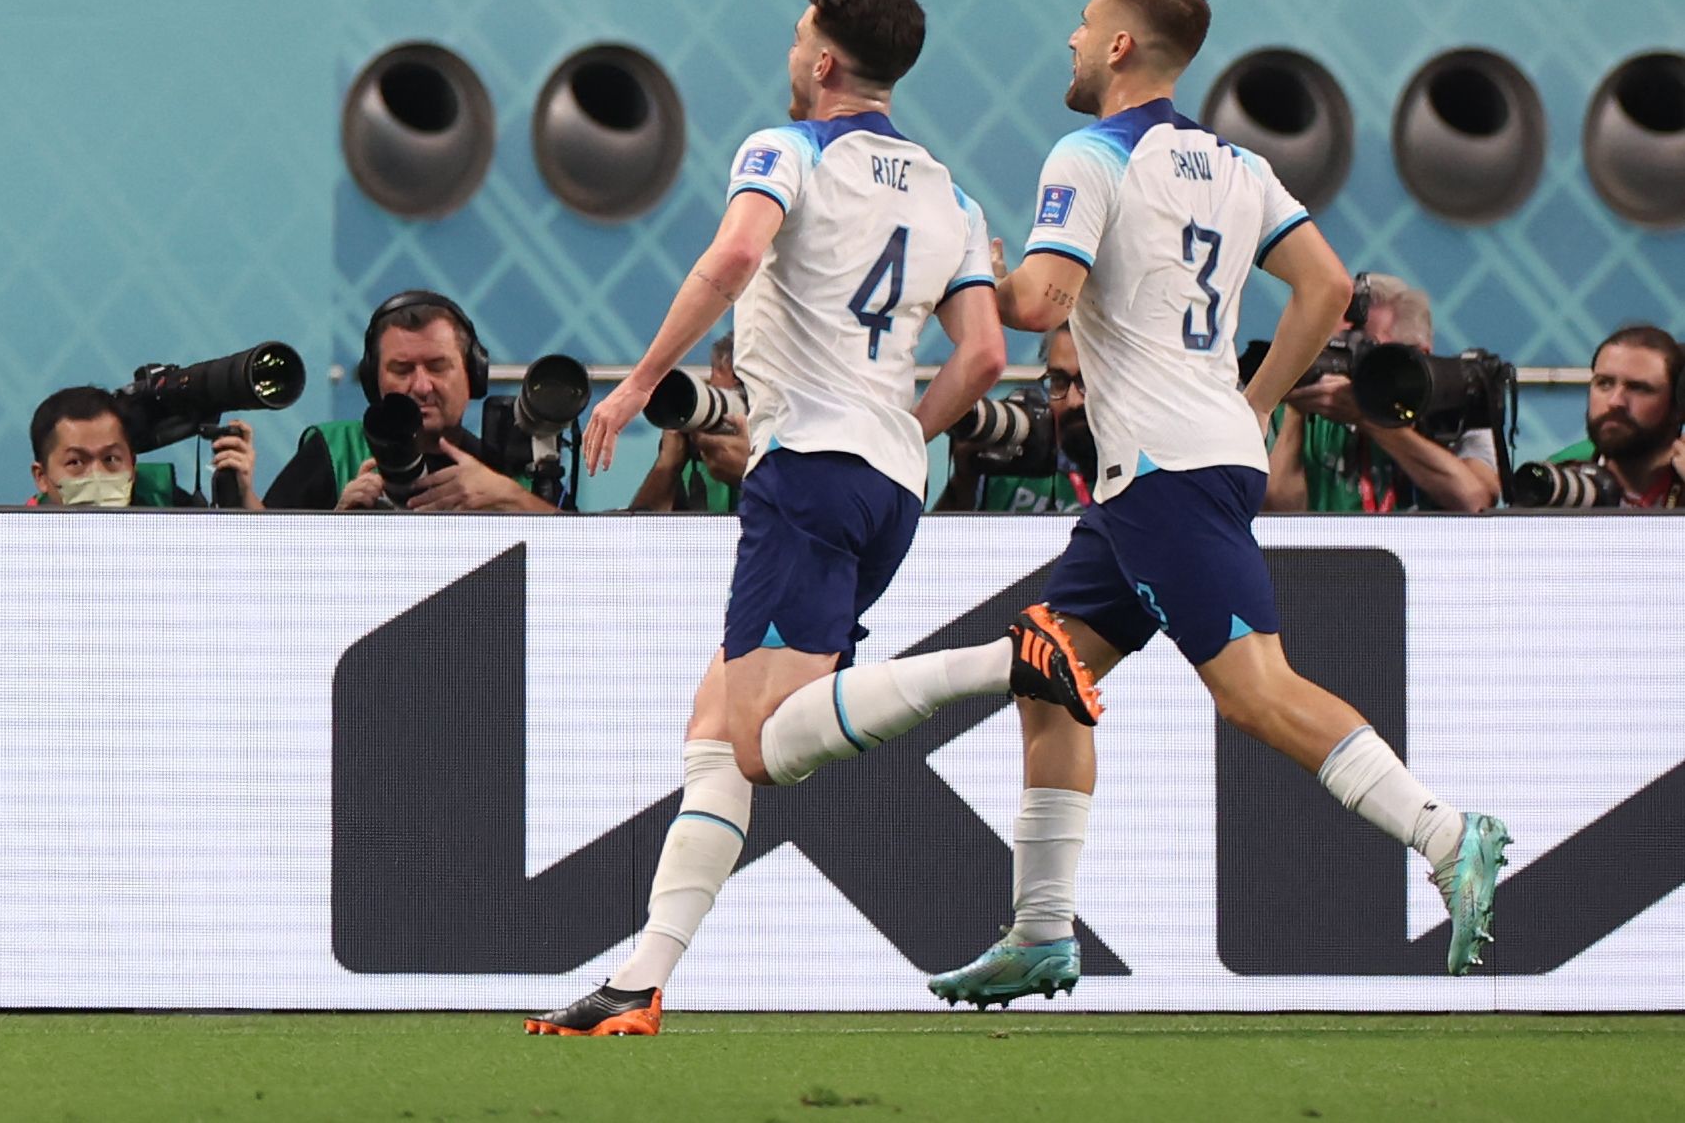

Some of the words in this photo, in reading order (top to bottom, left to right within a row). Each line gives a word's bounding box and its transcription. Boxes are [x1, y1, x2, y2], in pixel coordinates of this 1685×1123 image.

[871, 154, 911, 192] RICE
[847, 225, 909, 362] 4
[1181, 215, 1222, 351] 3
